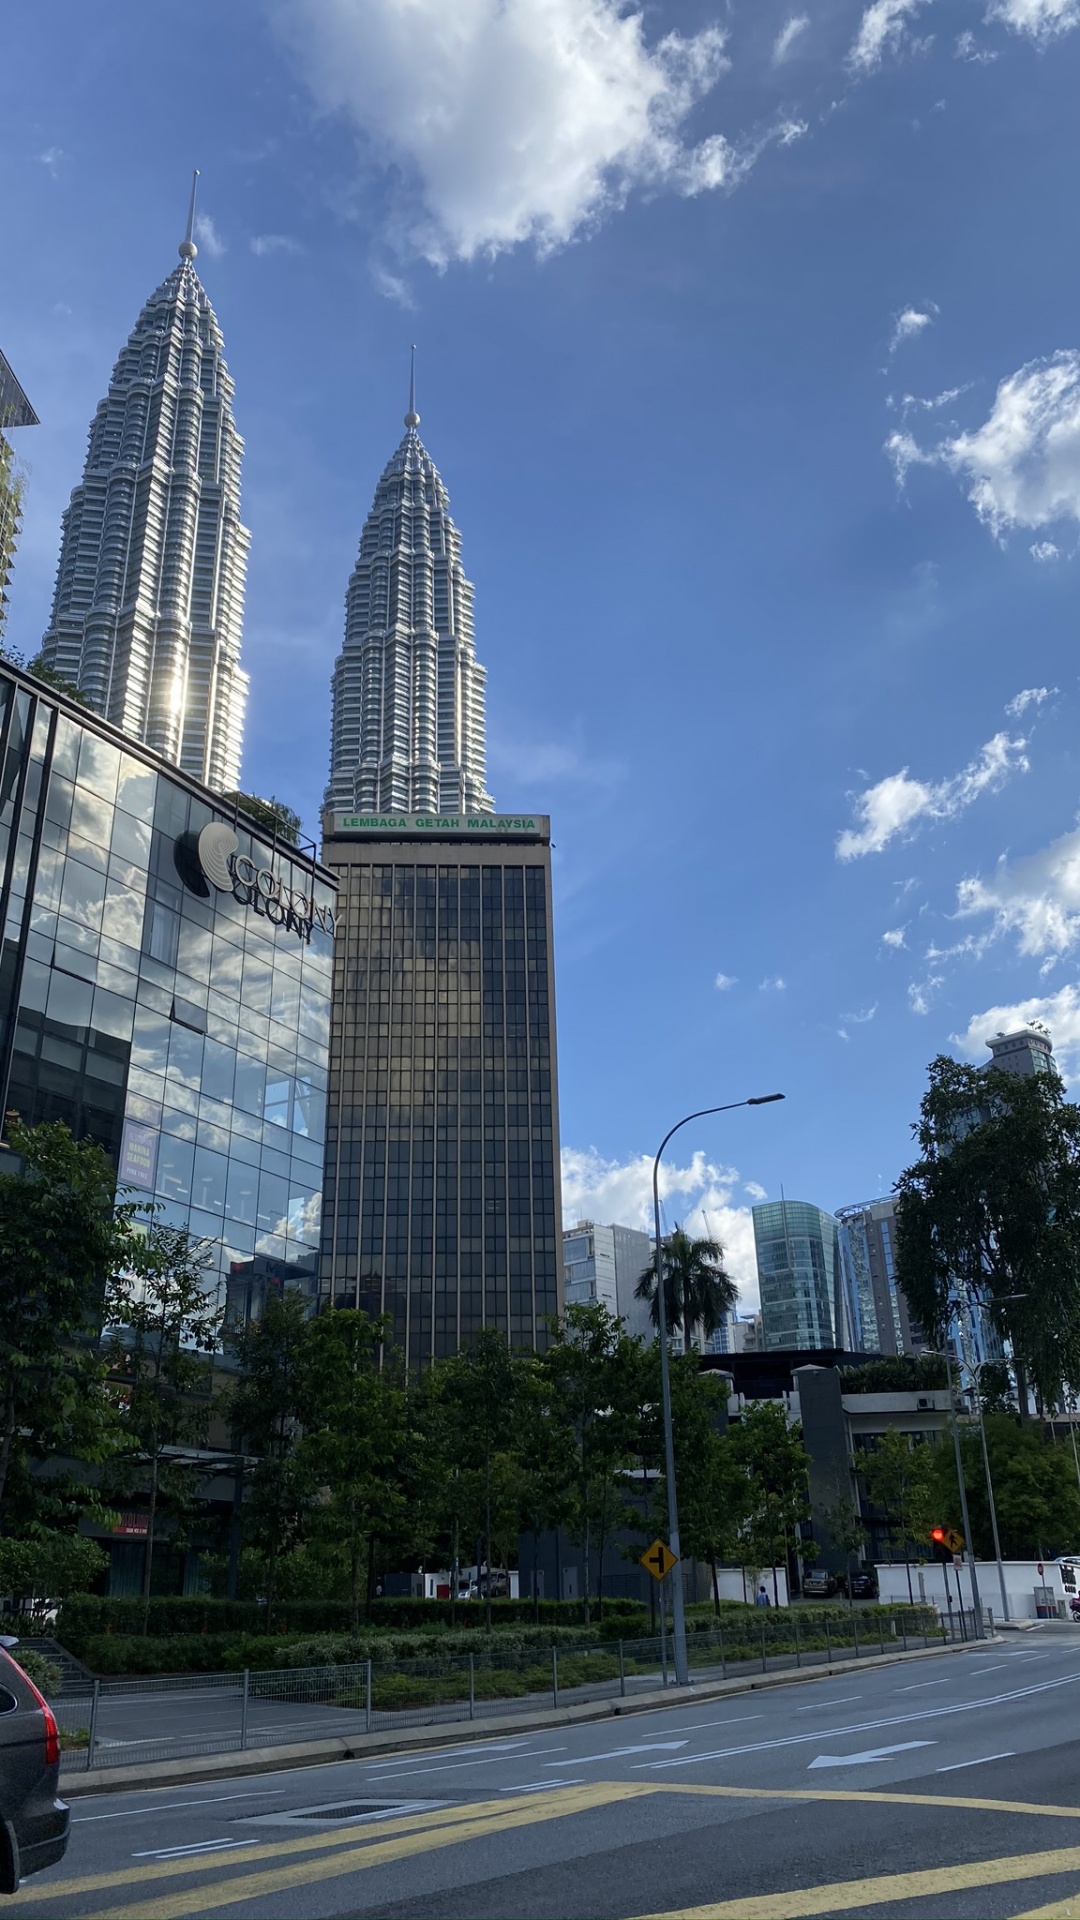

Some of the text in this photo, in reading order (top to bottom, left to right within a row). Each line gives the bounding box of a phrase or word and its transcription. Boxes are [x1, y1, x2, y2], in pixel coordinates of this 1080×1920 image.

[342, 817, 536, 829] LEMBAGA GETAH MALAYSIA
[235, 854, 343, 938] COLONY
[126, 1152, 151, 1168] SEAFOOD
